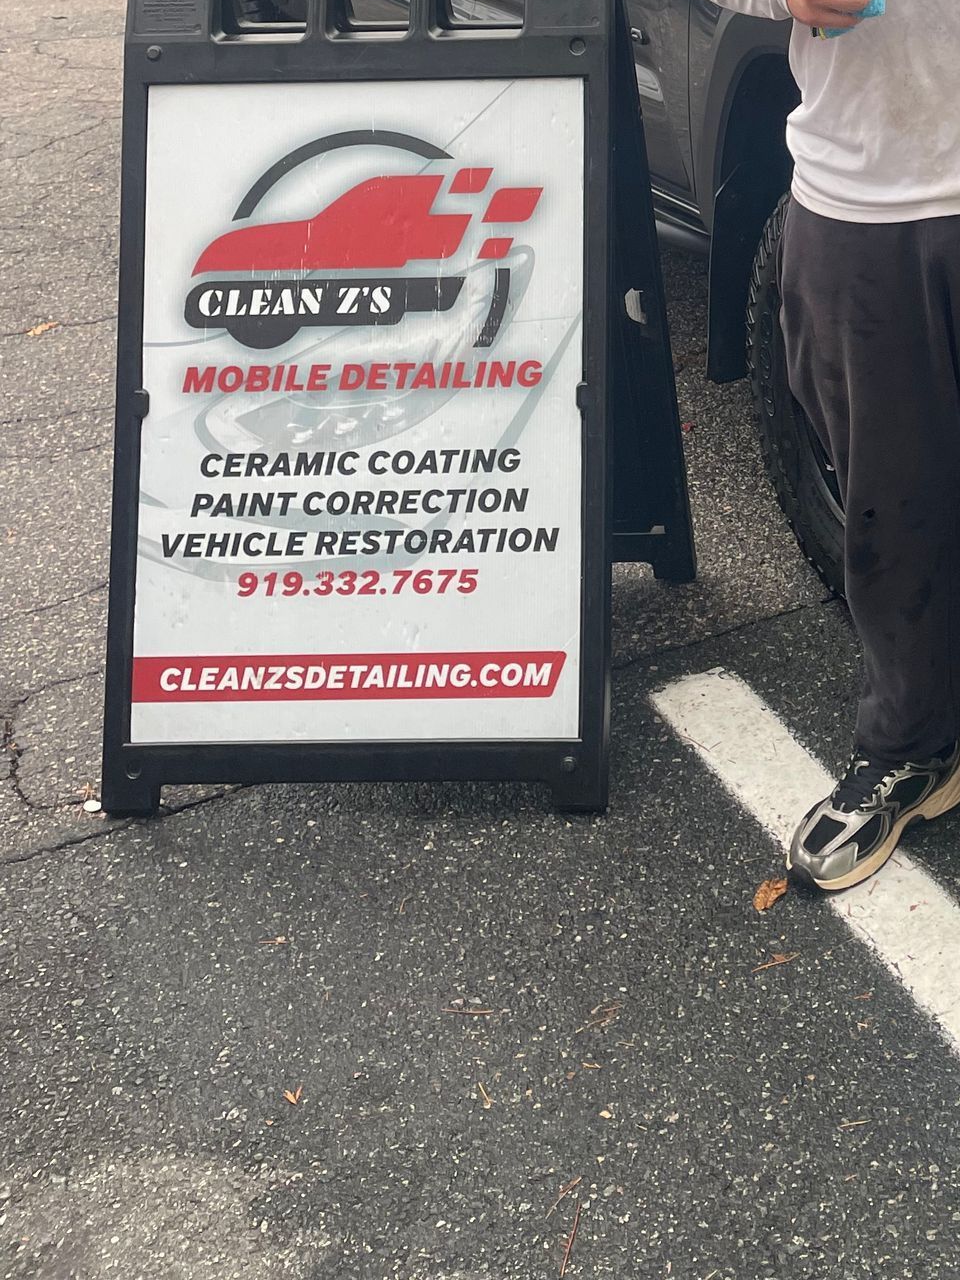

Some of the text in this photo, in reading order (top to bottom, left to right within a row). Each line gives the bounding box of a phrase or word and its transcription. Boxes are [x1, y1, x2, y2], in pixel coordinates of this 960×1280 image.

[199, 285, 392, 318] CLEAN Z'S
[182, 360, 543, 394] MOBILE DETAILING
[200, 448, 521, 478] CERAMIC COATING
[190, 488, 529, 518] PAINT CORRECTION
[161, 527, 560, 558] VEHICLE RESTORATION
[236, 568, 479, 597] 919.332.7675
[159, 662, 553, 692] CLEANZSDETAILING.COM
